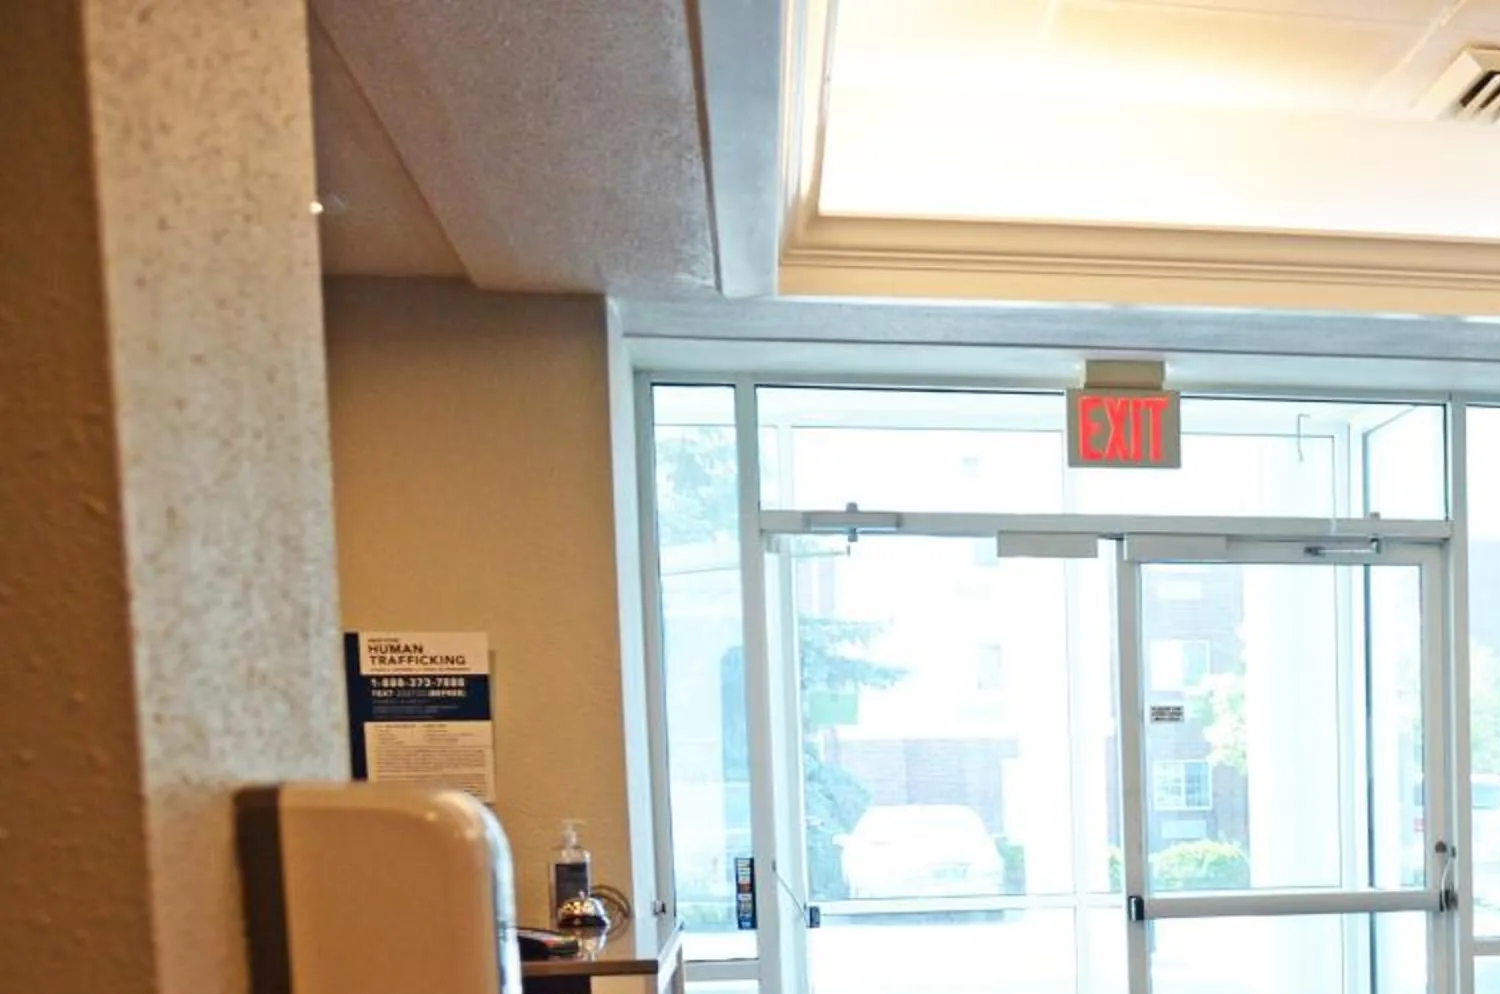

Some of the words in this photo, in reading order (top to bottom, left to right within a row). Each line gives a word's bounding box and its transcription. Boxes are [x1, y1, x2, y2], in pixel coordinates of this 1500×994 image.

[1079, 396, 1169, 463] EXIT
[368, 644, 424, 654] HUMAN
[370, 656, 466, 666] TRAFFICKING
